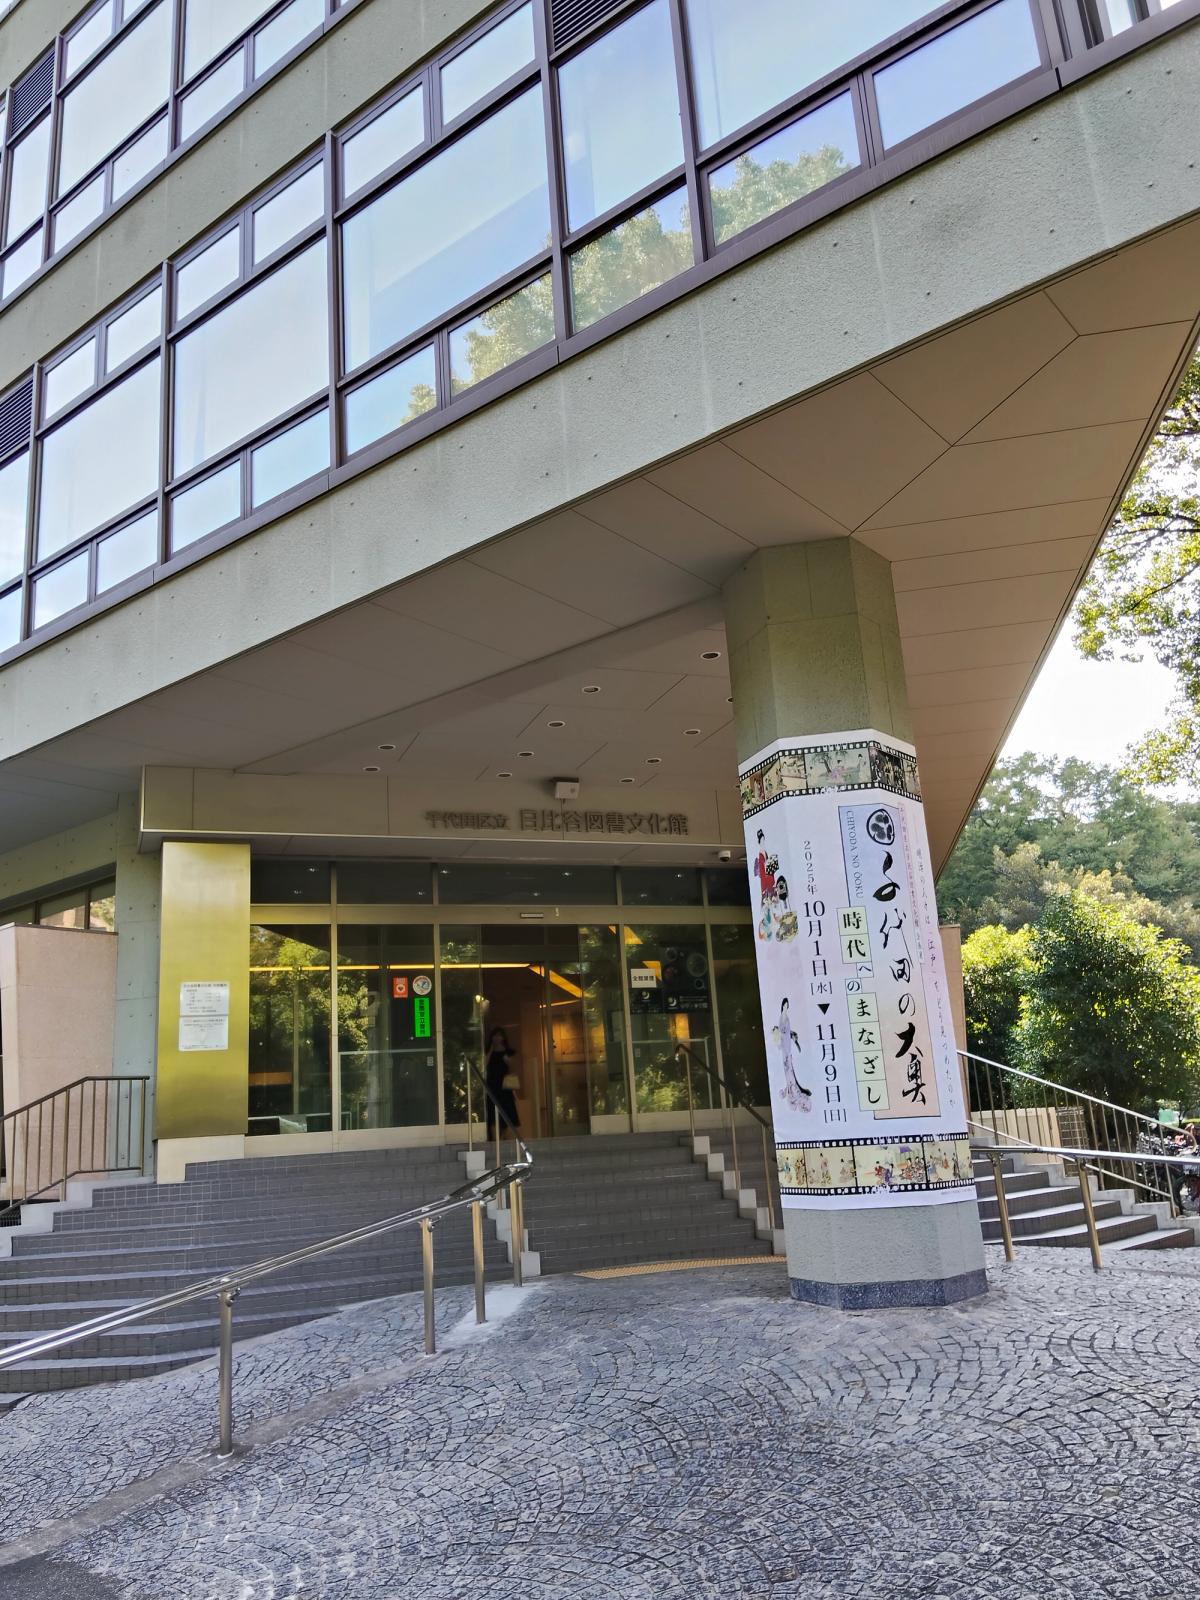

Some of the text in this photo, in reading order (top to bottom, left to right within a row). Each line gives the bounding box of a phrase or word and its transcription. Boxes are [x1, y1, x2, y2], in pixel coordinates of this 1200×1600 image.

[846, 810, 858, 852] CHIYODA
[852, 855, 860, 869] NO
[803, 841, 819, 895] 2025年
